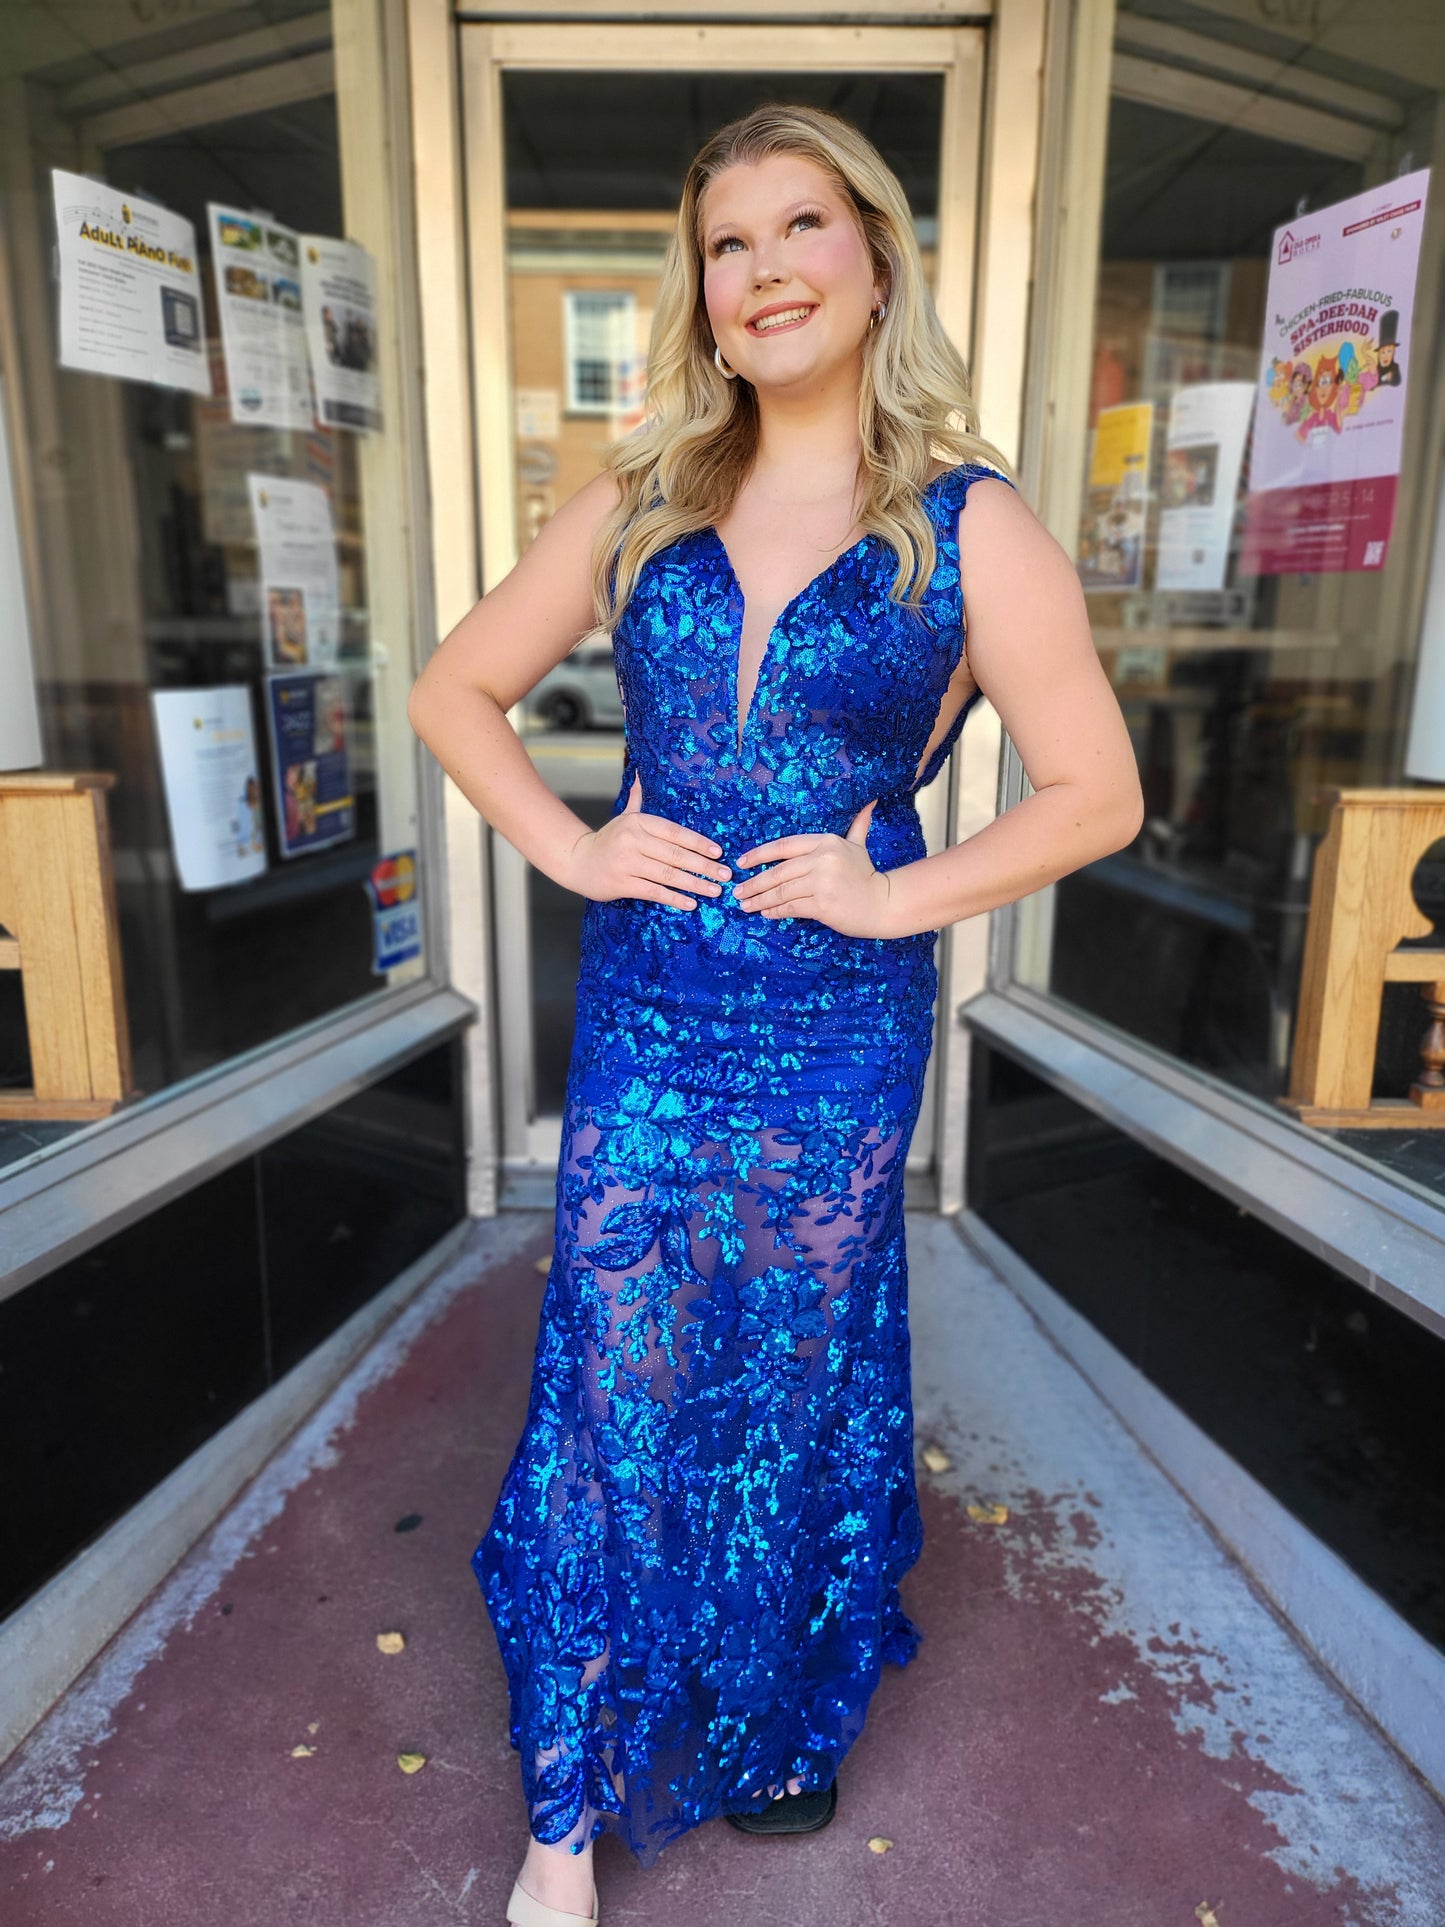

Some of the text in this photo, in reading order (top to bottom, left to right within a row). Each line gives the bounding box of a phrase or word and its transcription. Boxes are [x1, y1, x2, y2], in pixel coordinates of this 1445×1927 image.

[1279, 288, 1393, 338] CHICKEN-FRIED-FABULOUS
[1290, 302, 1378, 345] SPA-DEE-DAH
[1293, 319, 1370, 357] SISTERHOOD
